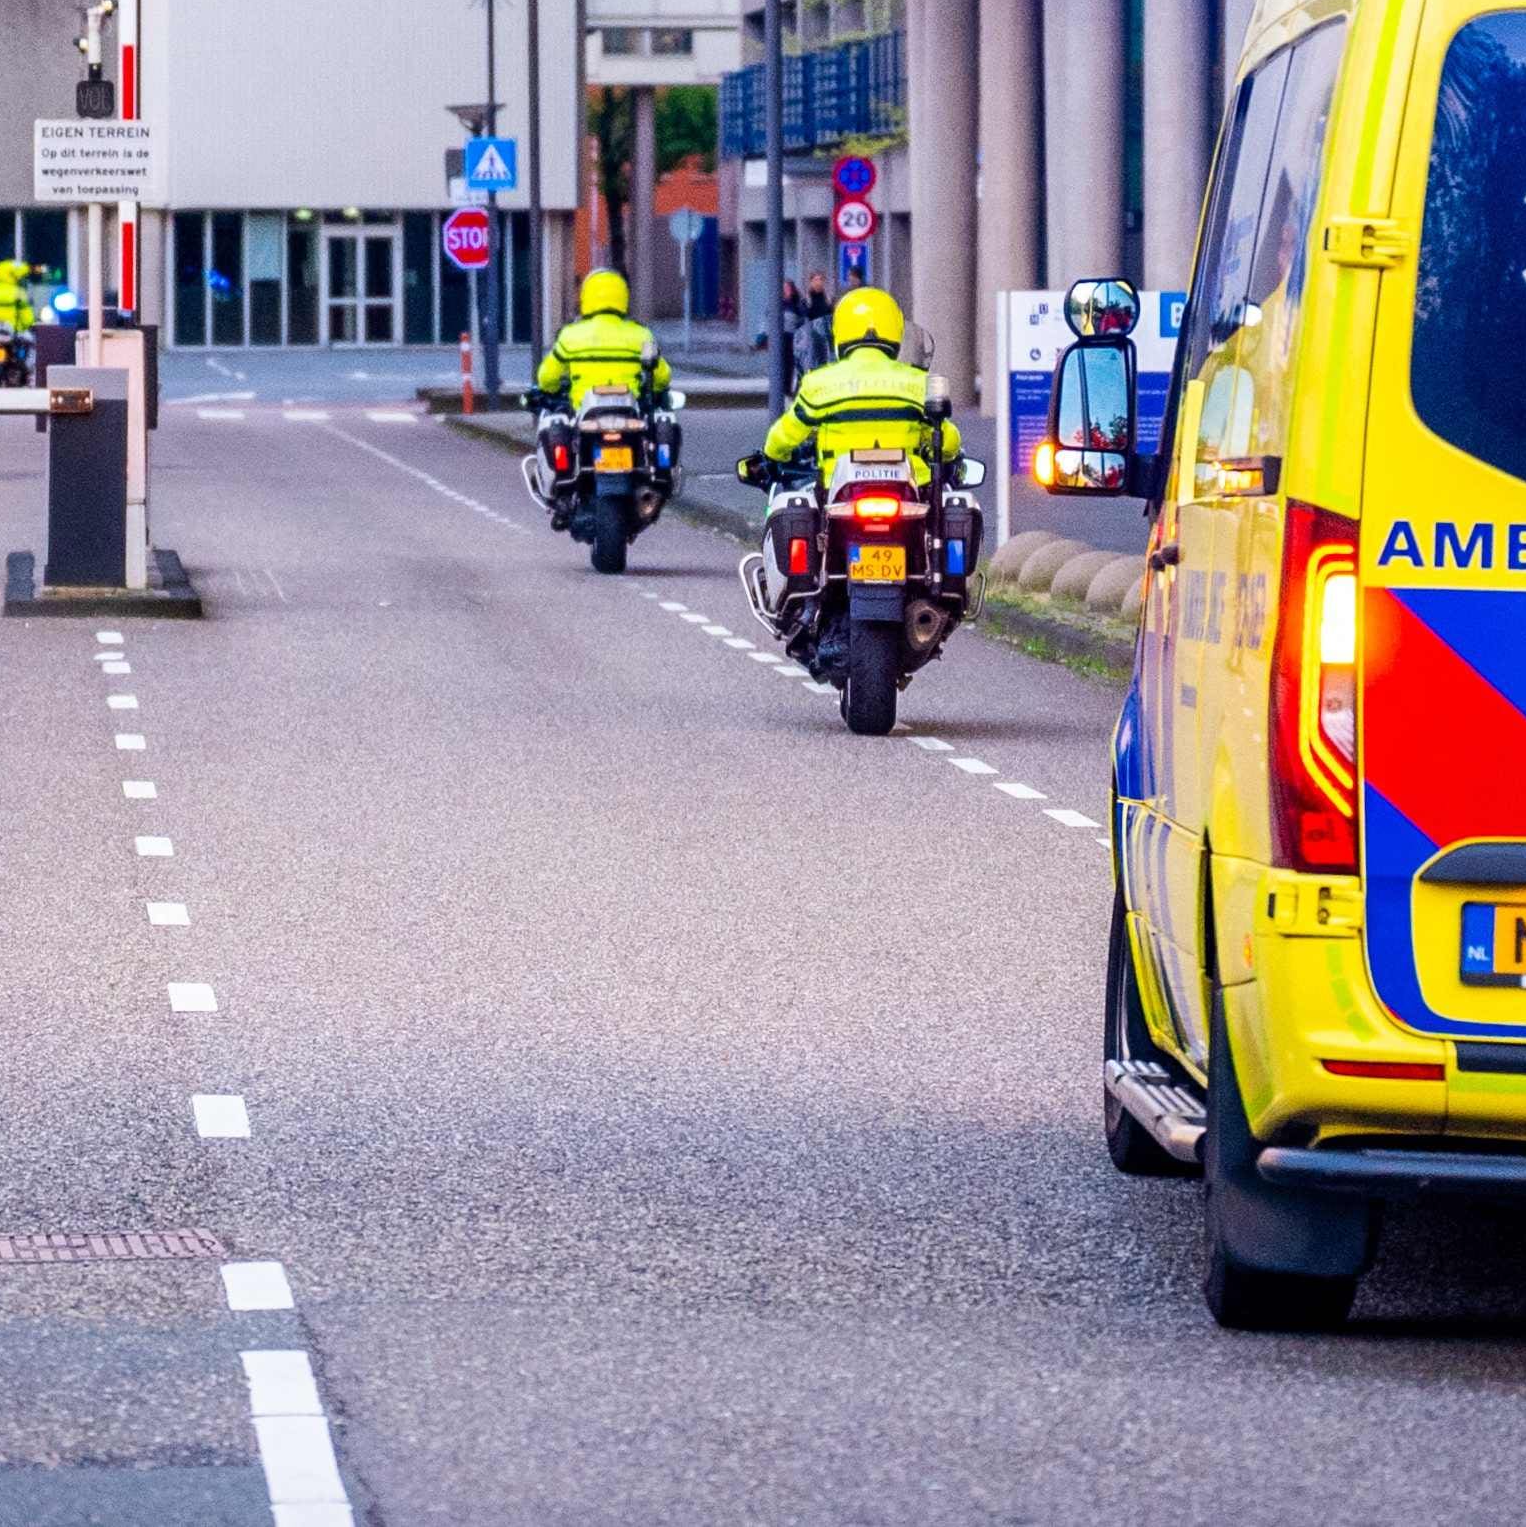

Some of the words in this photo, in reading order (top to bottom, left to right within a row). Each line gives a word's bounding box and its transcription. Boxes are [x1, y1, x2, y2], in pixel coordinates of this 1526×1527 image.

[41, 126, 84, 139] EIGEN
[89, 126, 150, 139] TERREIN
[41, 148, 57, 159] Op
[61, 148, 76, 158] dit
[80, 148, 119, 158] terrein
[123, 148, 133, 158] is
[136, 148, 150, 158] de
[41, 167, 148, 178] wegenverkeerswet
[52, 185, 73, 194] van
[78, 185, 139, 196] toepassing
[843, 211, 869, 228] 20
[855, 469, 900, 479] POLITIE
[872, 549, 893, 561] 49
[1467, 945, 1490, 961] NL
